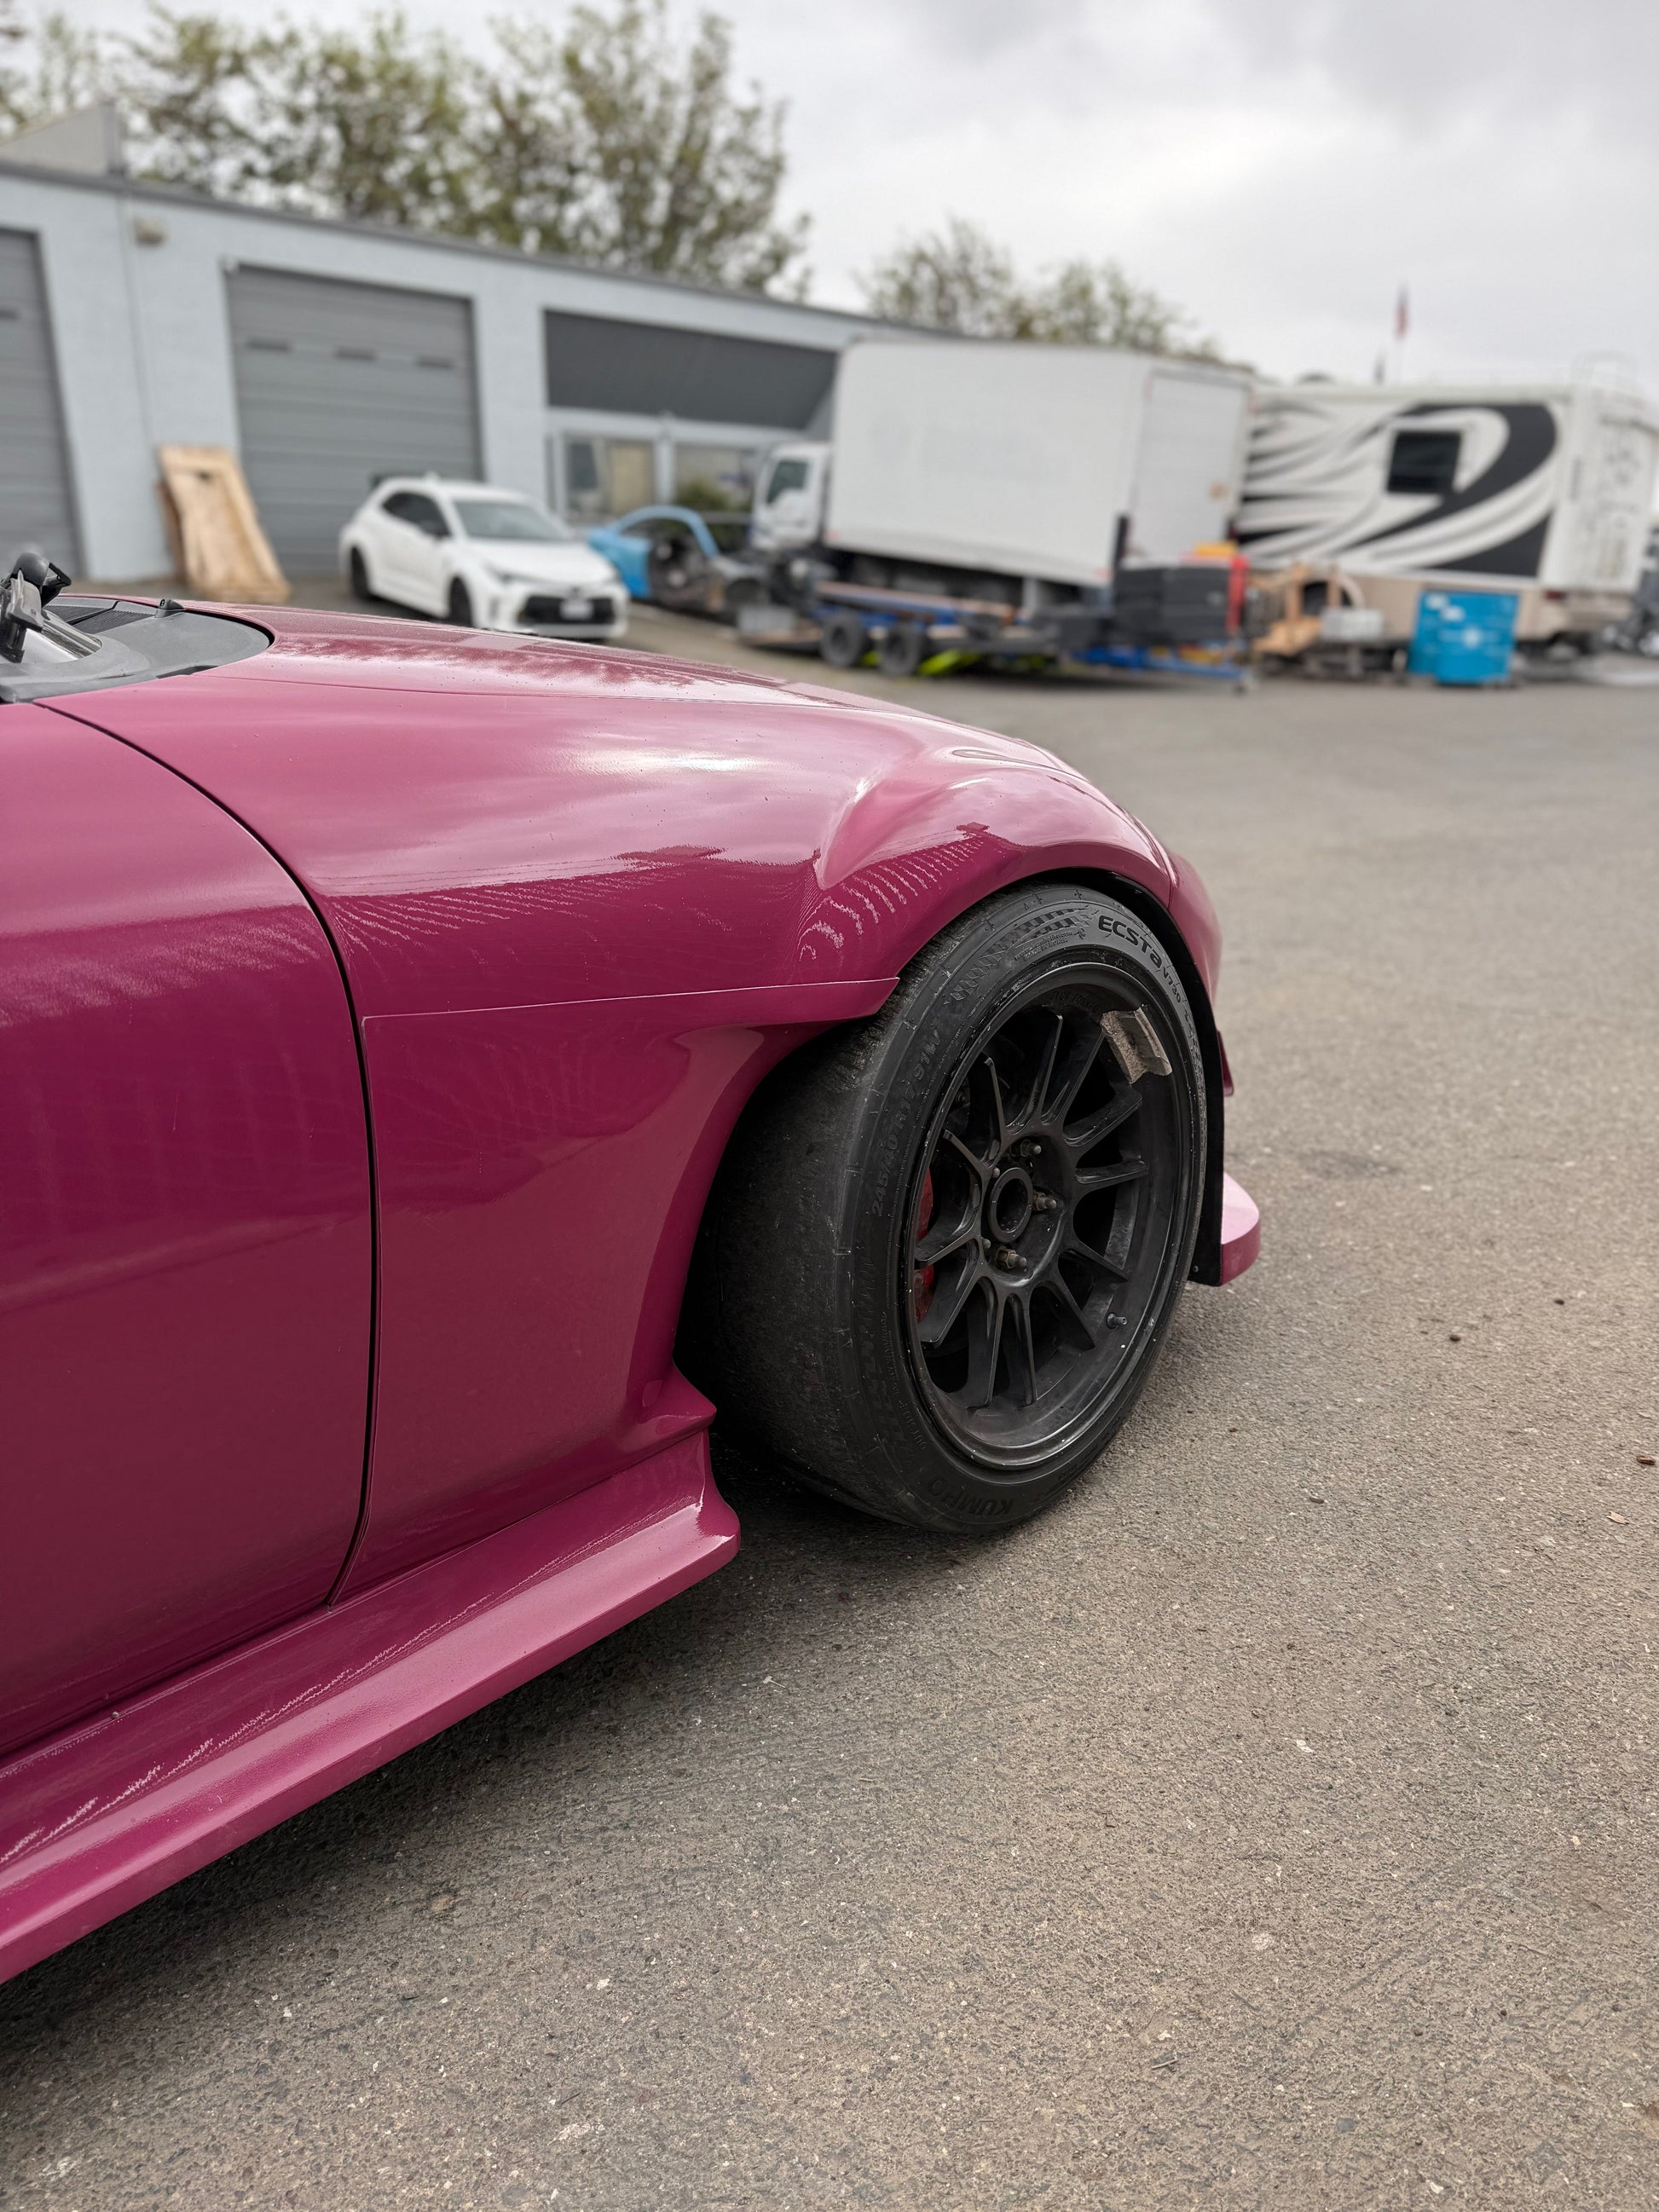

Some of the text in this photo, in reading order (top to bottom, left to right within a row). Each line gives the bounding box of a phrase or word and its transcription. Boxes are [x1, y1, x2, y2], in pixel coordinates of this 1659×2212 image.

[871, 1133, 899, 1217] 245/40
[893, 1081, 916, 1129] R17
[913, 1028, 942, 1080] 91W
[927, 1476, 1015, 1516] KUMHO
